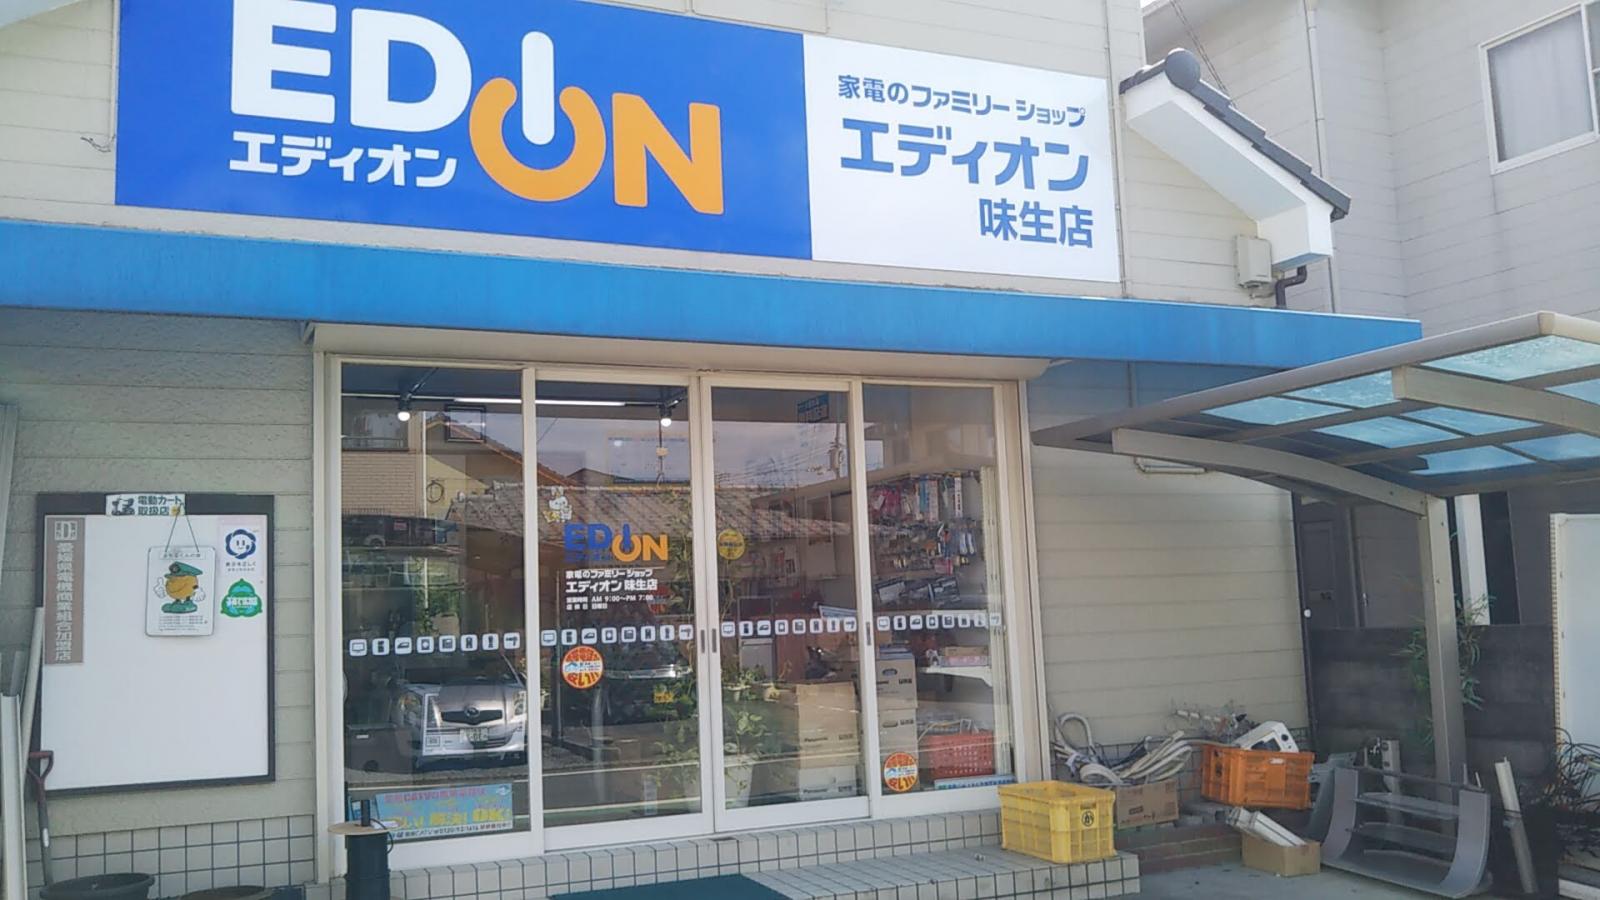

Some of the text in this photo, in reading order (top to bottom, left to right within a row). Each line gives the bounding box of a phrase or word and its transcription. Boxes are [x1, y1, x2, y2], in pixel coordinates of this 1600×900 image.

[230, 0, 725, 215] EDION
[837, 74, 1086, 128] 家電のファミリーショップ
[229, 130, 458, 188] エディオン
[840, 117, 1090, 192] エディオン
[978, 197, 1094, 249] 味生店
[137, 495, 182, 505] 電動カート
[137, 505, 170, 515] 取扱店
[563, 522, 669, 562] EDION
[565, 578, 658, 593] エディオン 味生店
